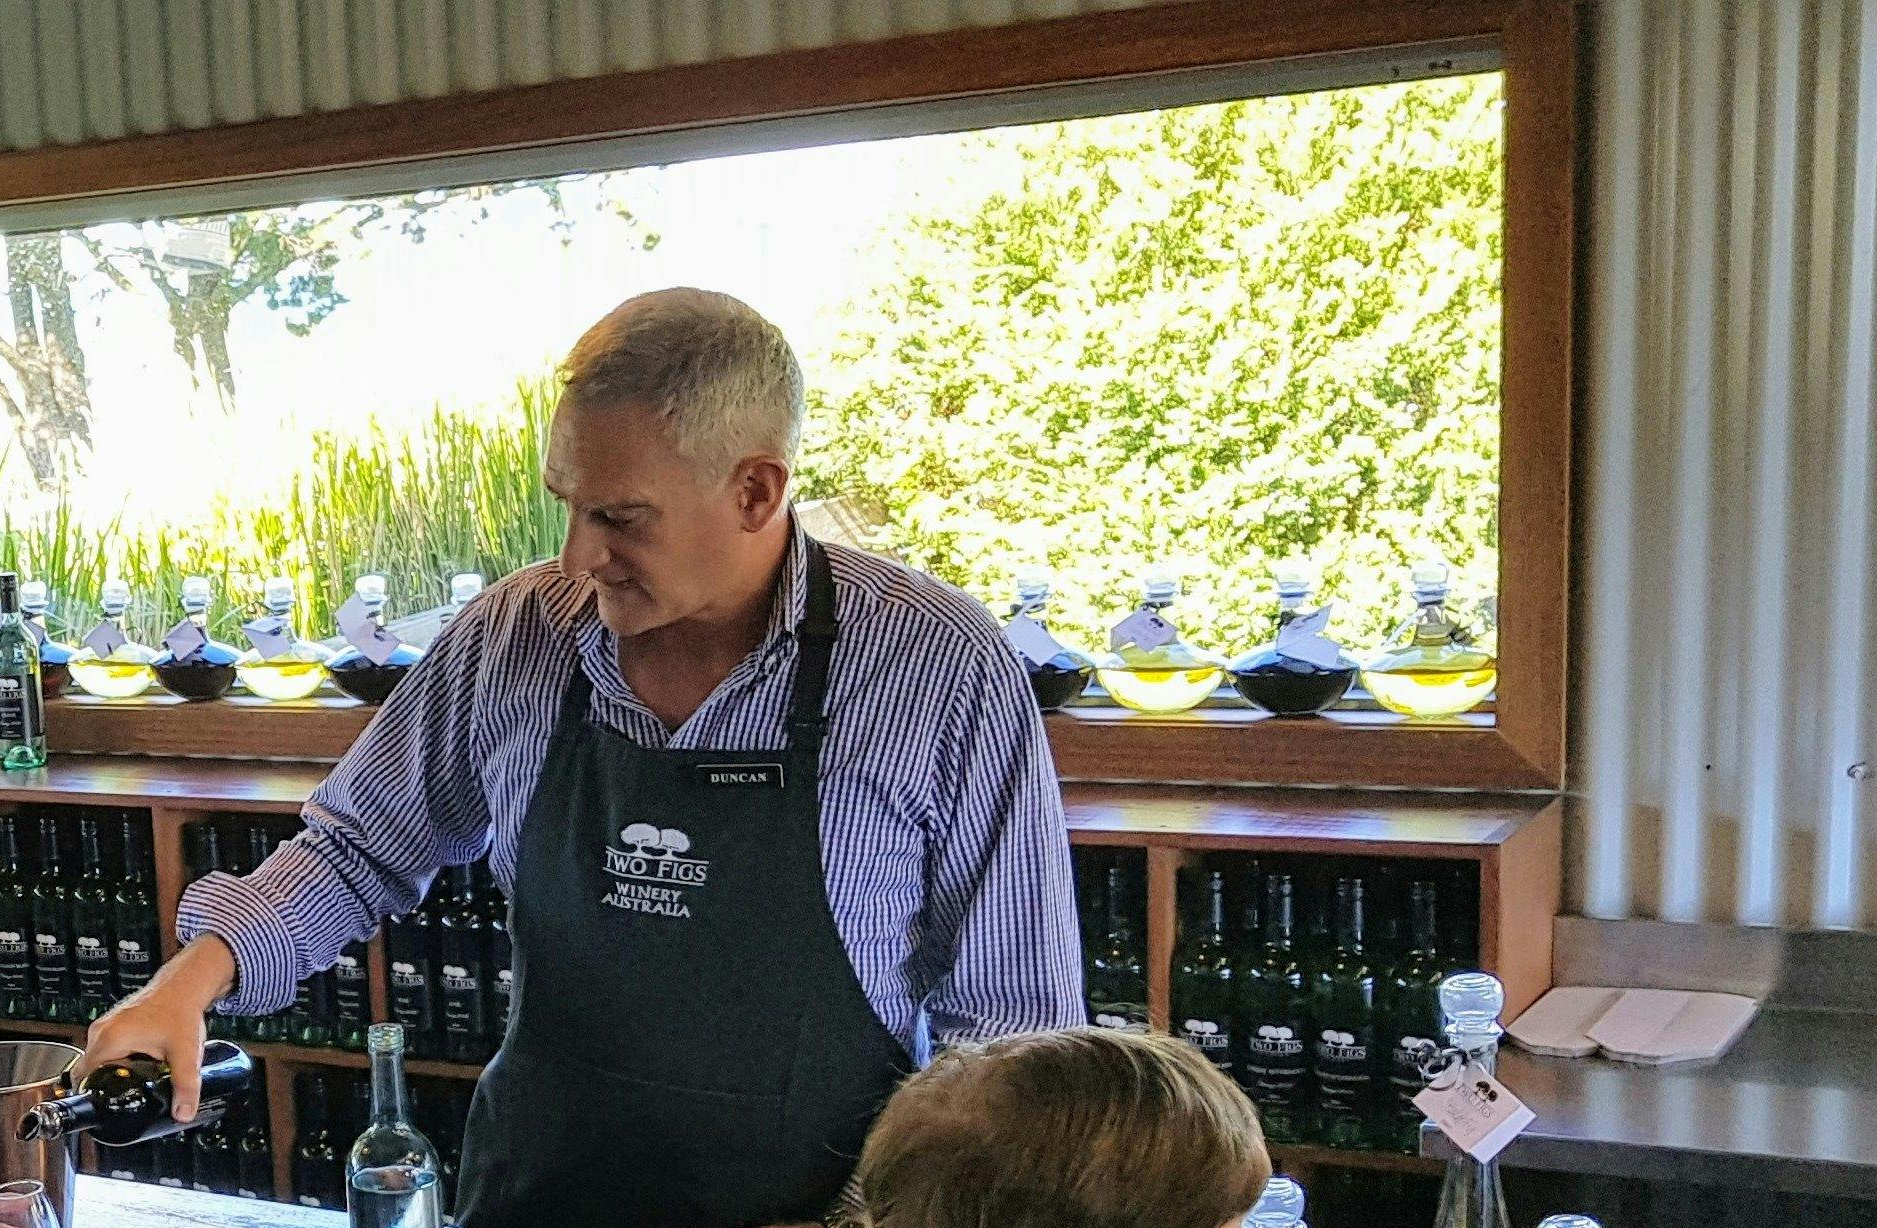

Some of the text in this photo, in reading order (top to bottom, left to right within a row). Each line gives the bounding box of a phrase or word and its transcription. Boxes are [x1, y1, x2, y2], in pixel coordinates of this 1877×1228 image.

[710, 772, 767, 784] DUNCAN
[605, 850, 707, 882] TWO FIGS
[615, 881, 682, 903] WINERY
[601, 892, 691, 919] AUSTRALIA
